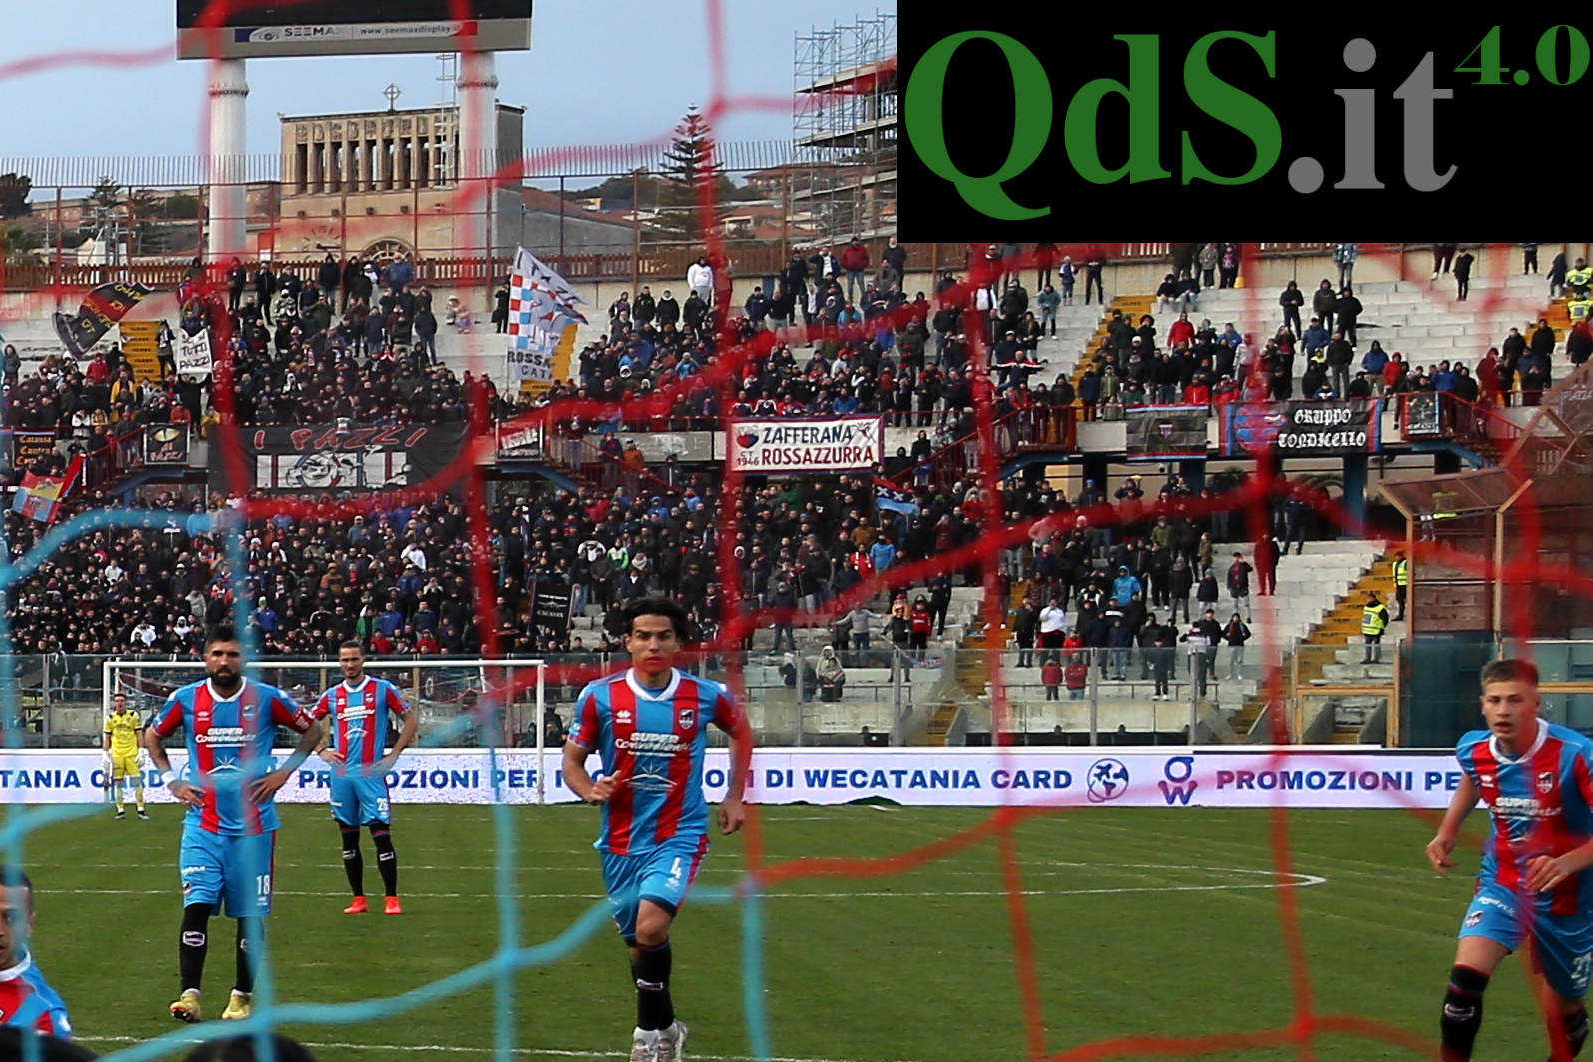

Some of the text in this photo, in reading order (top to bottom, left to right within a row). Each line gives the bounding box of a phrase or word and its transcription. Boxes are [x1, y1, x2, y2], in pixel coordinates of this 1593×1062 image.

[285, 26, 339, 37] SEEMA
[1294, 408, 1351, 426] GRUPPO
[762, 424, 853, 444] ZAFFERANA
[762, 446, 874, 465] ROSSAZZURRA
[90, 769, 164, 789] CRD
[299, 770, 479, 788] PROZIONI
[766, 769, 793, 788] DI
[804, 769, 981, 788] WECATANIA
[991, 769, 1073, 789] CARD
[1216, 770, 1460, 790] PROMOZIONI PE
[669, 857, 680, 879] 4
[256, 875, 270, 895] 18
